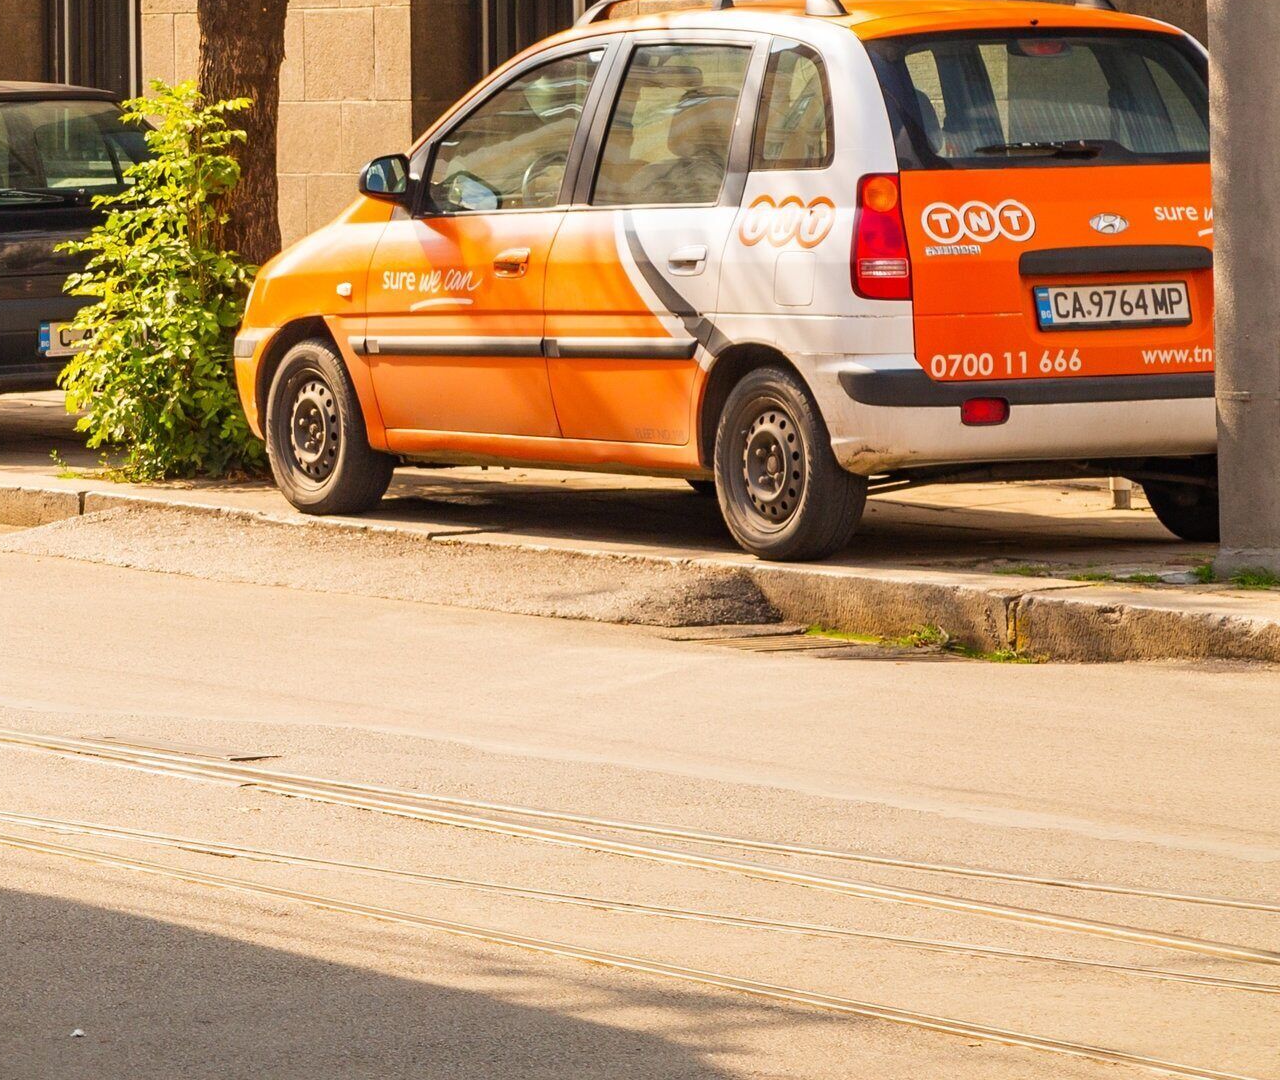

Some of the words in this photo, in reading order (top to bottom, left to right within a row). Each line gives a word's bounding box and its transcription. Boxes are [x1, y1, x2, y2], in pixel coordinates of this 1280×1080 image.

[928, 207, 1026, 237] TNT
[1153, 206, 1199, 222] sure
[382, 270, 416, 291] sure
[418, 270, 442, 293] we
[444, 268, 483, 292] can
[1041, 310, 1052, 319] BG
[930, 353, 994, 378] 0700
[1002, 351, 1027, 375] 11
[1039, 348, 1083, 373] 666
[1141, 345, 1214, 365] www.tn
